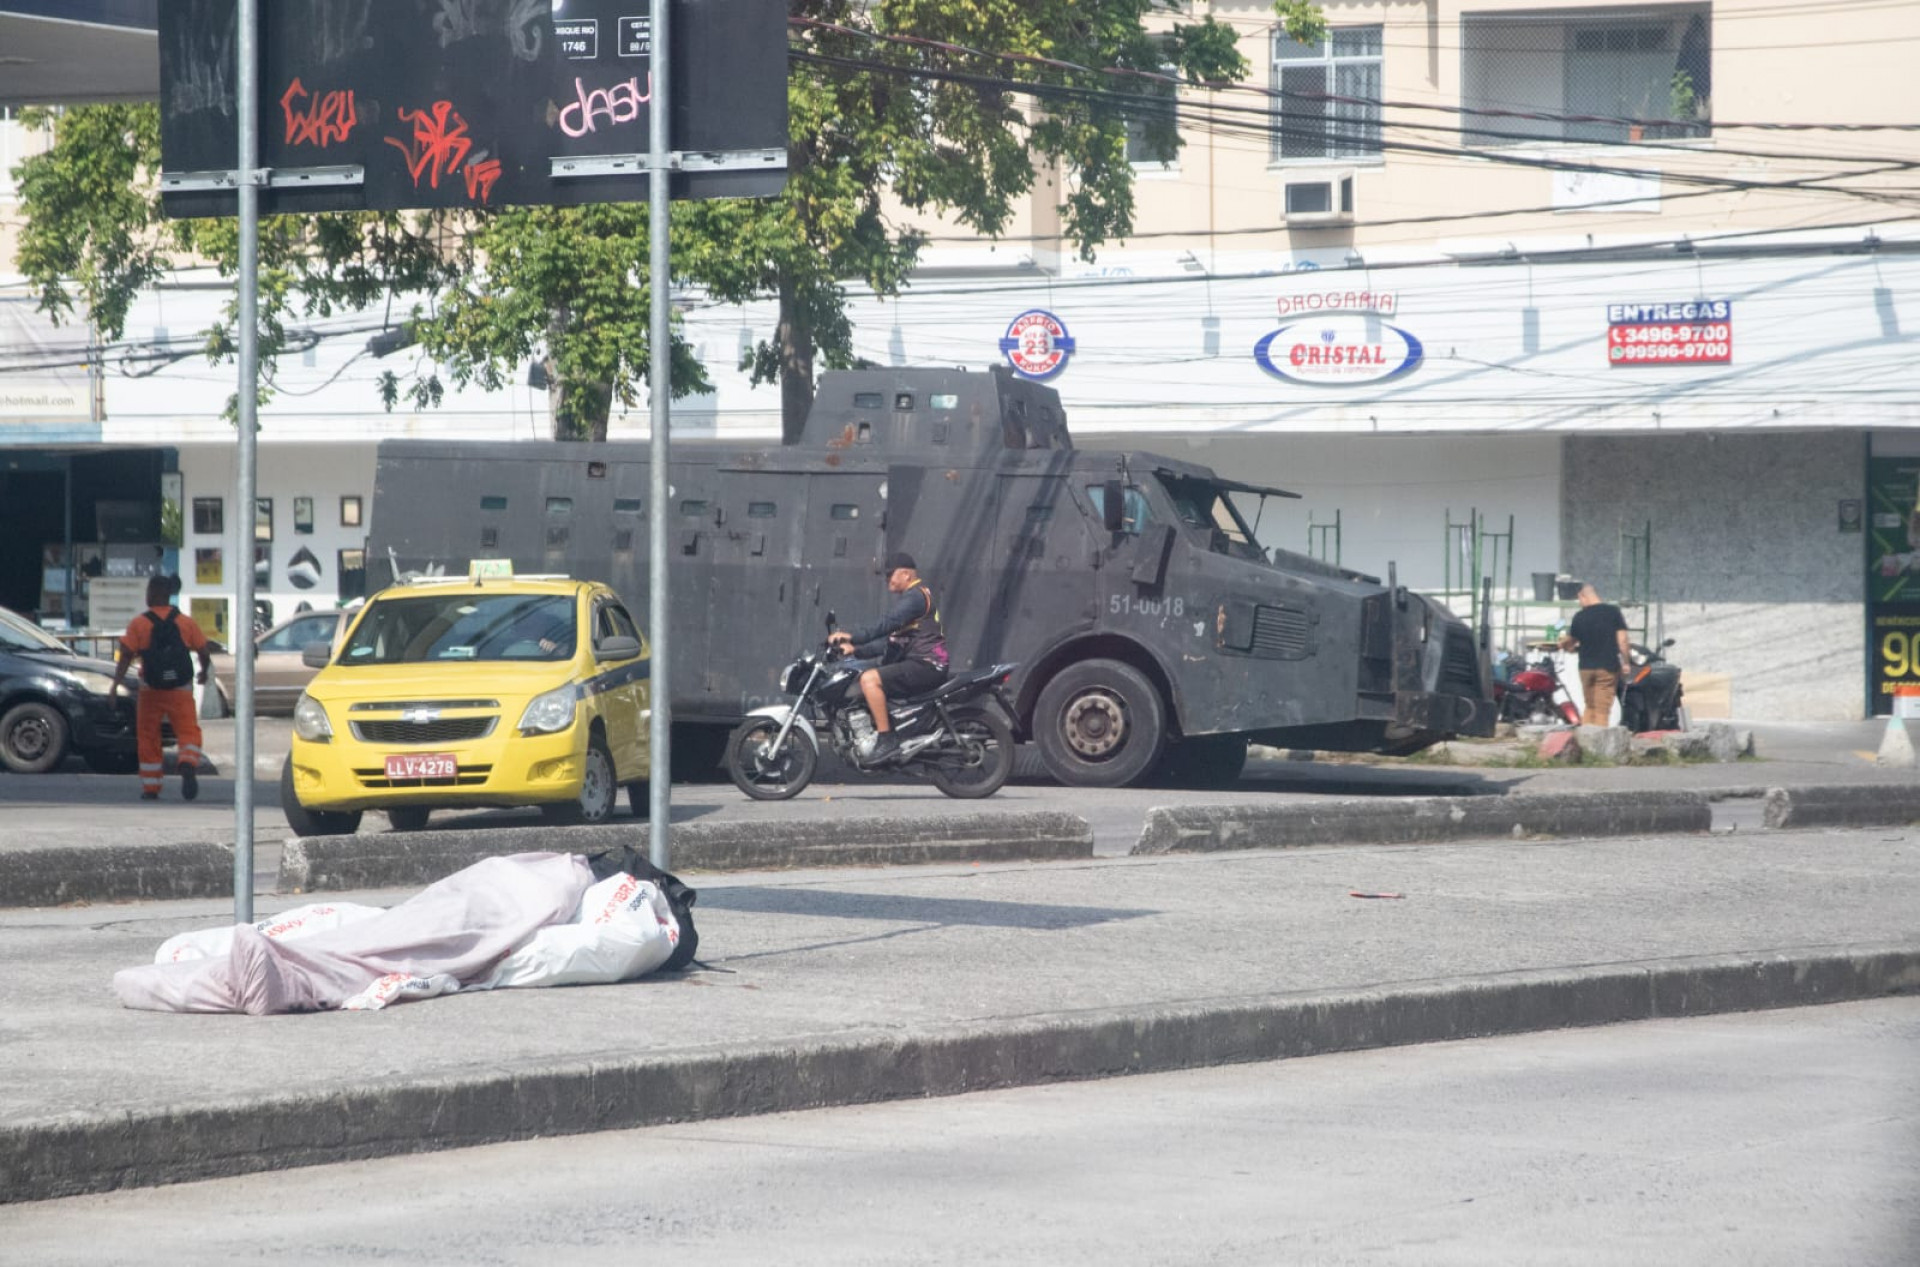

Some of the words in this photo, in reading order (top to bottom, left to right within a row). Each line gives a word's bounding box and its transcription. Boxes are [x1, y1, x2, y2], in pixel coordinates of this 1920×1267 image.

[562, 41, 587, 52] 1746
[1277, 290, 1393, 315] DROGARIA
[1609, 301, 1728, 322] ENTREGAS
[1625, 326, 1727, 342] 3496-9700
[1025, 339, 1049, 356] 23
[1289, 344, 1387, 366] CRISTAL
[1110, 595, 1183, 616] 51-0018
